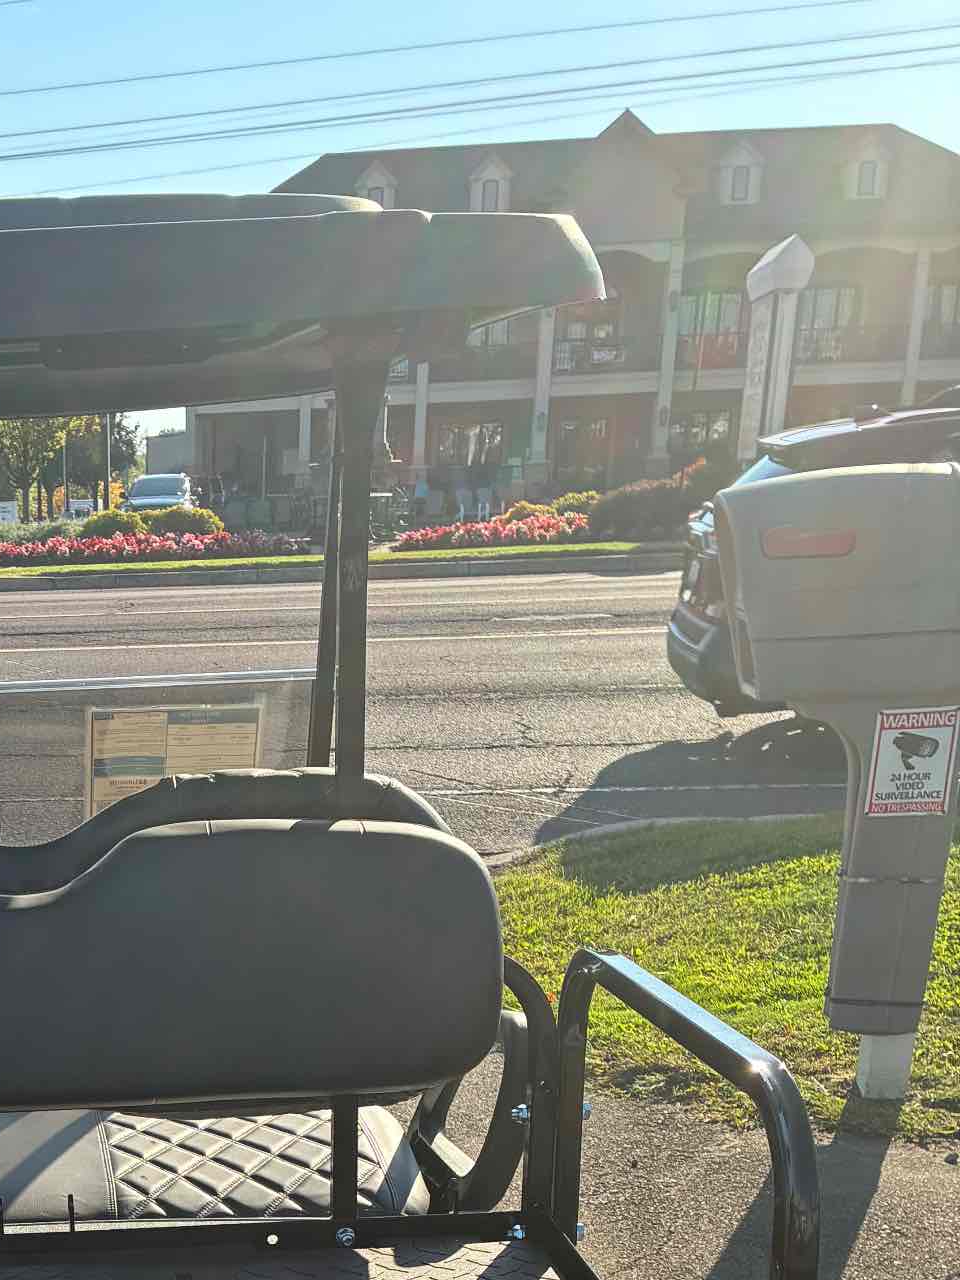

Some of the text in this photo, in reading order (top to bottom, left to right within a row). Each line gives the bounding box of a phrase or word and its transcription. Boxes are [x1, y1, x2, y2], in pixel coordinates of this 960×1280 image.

[882, 712, 956, 729] WARNING
[889, 772, 931, 783] 24 HOUR
[896, 781, 924, 791] VIDEO
[875, 791, 944, 801] SURVEILLANCE
